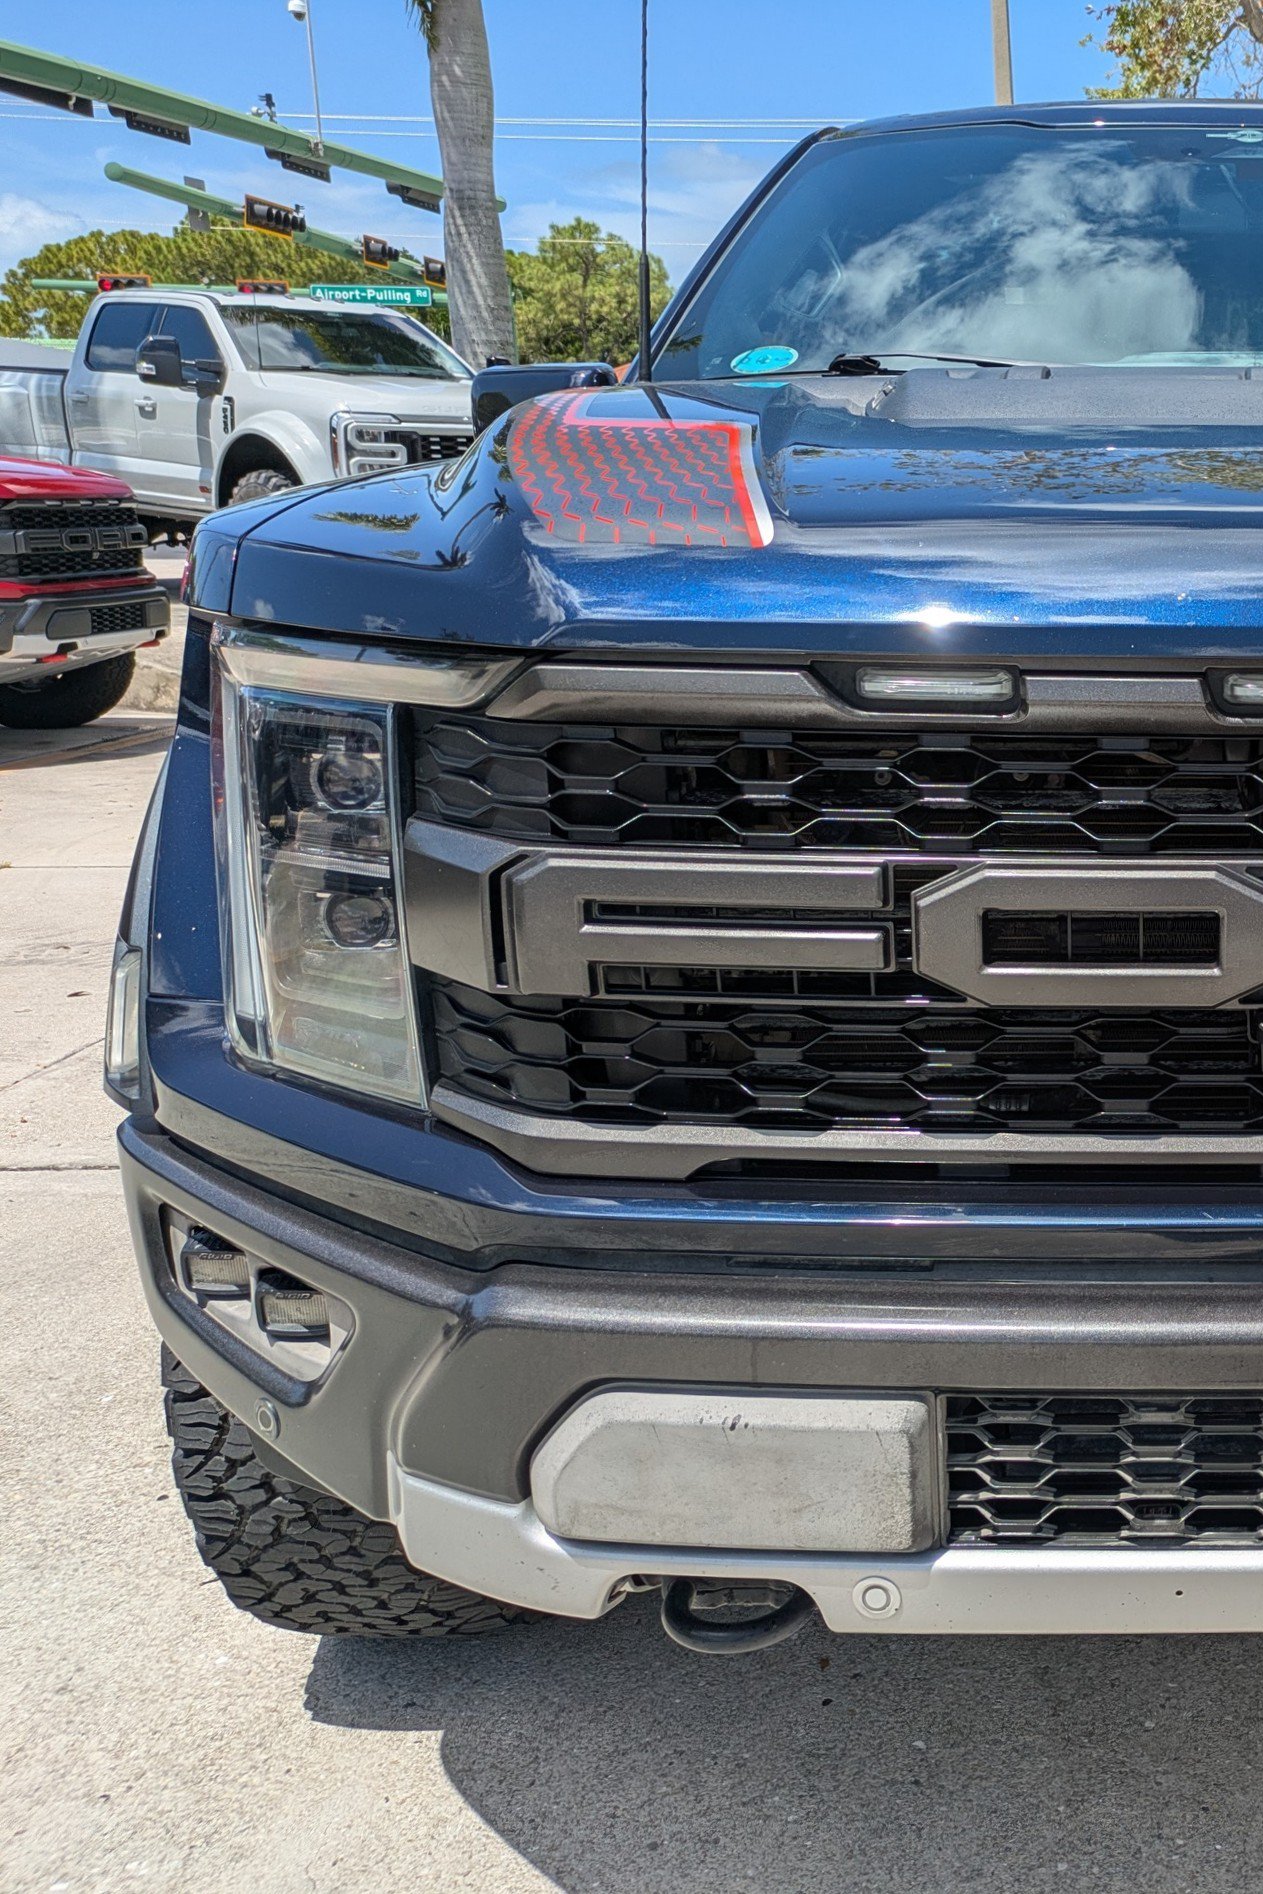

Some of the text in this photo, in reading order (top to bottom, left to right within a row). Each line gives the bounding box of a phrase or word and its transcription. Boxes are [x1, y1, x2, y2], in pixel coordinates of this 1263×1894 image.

[315, 288, 427, 304] Airport-Pulling Rd
[16, 524, 148, 553] FORD
